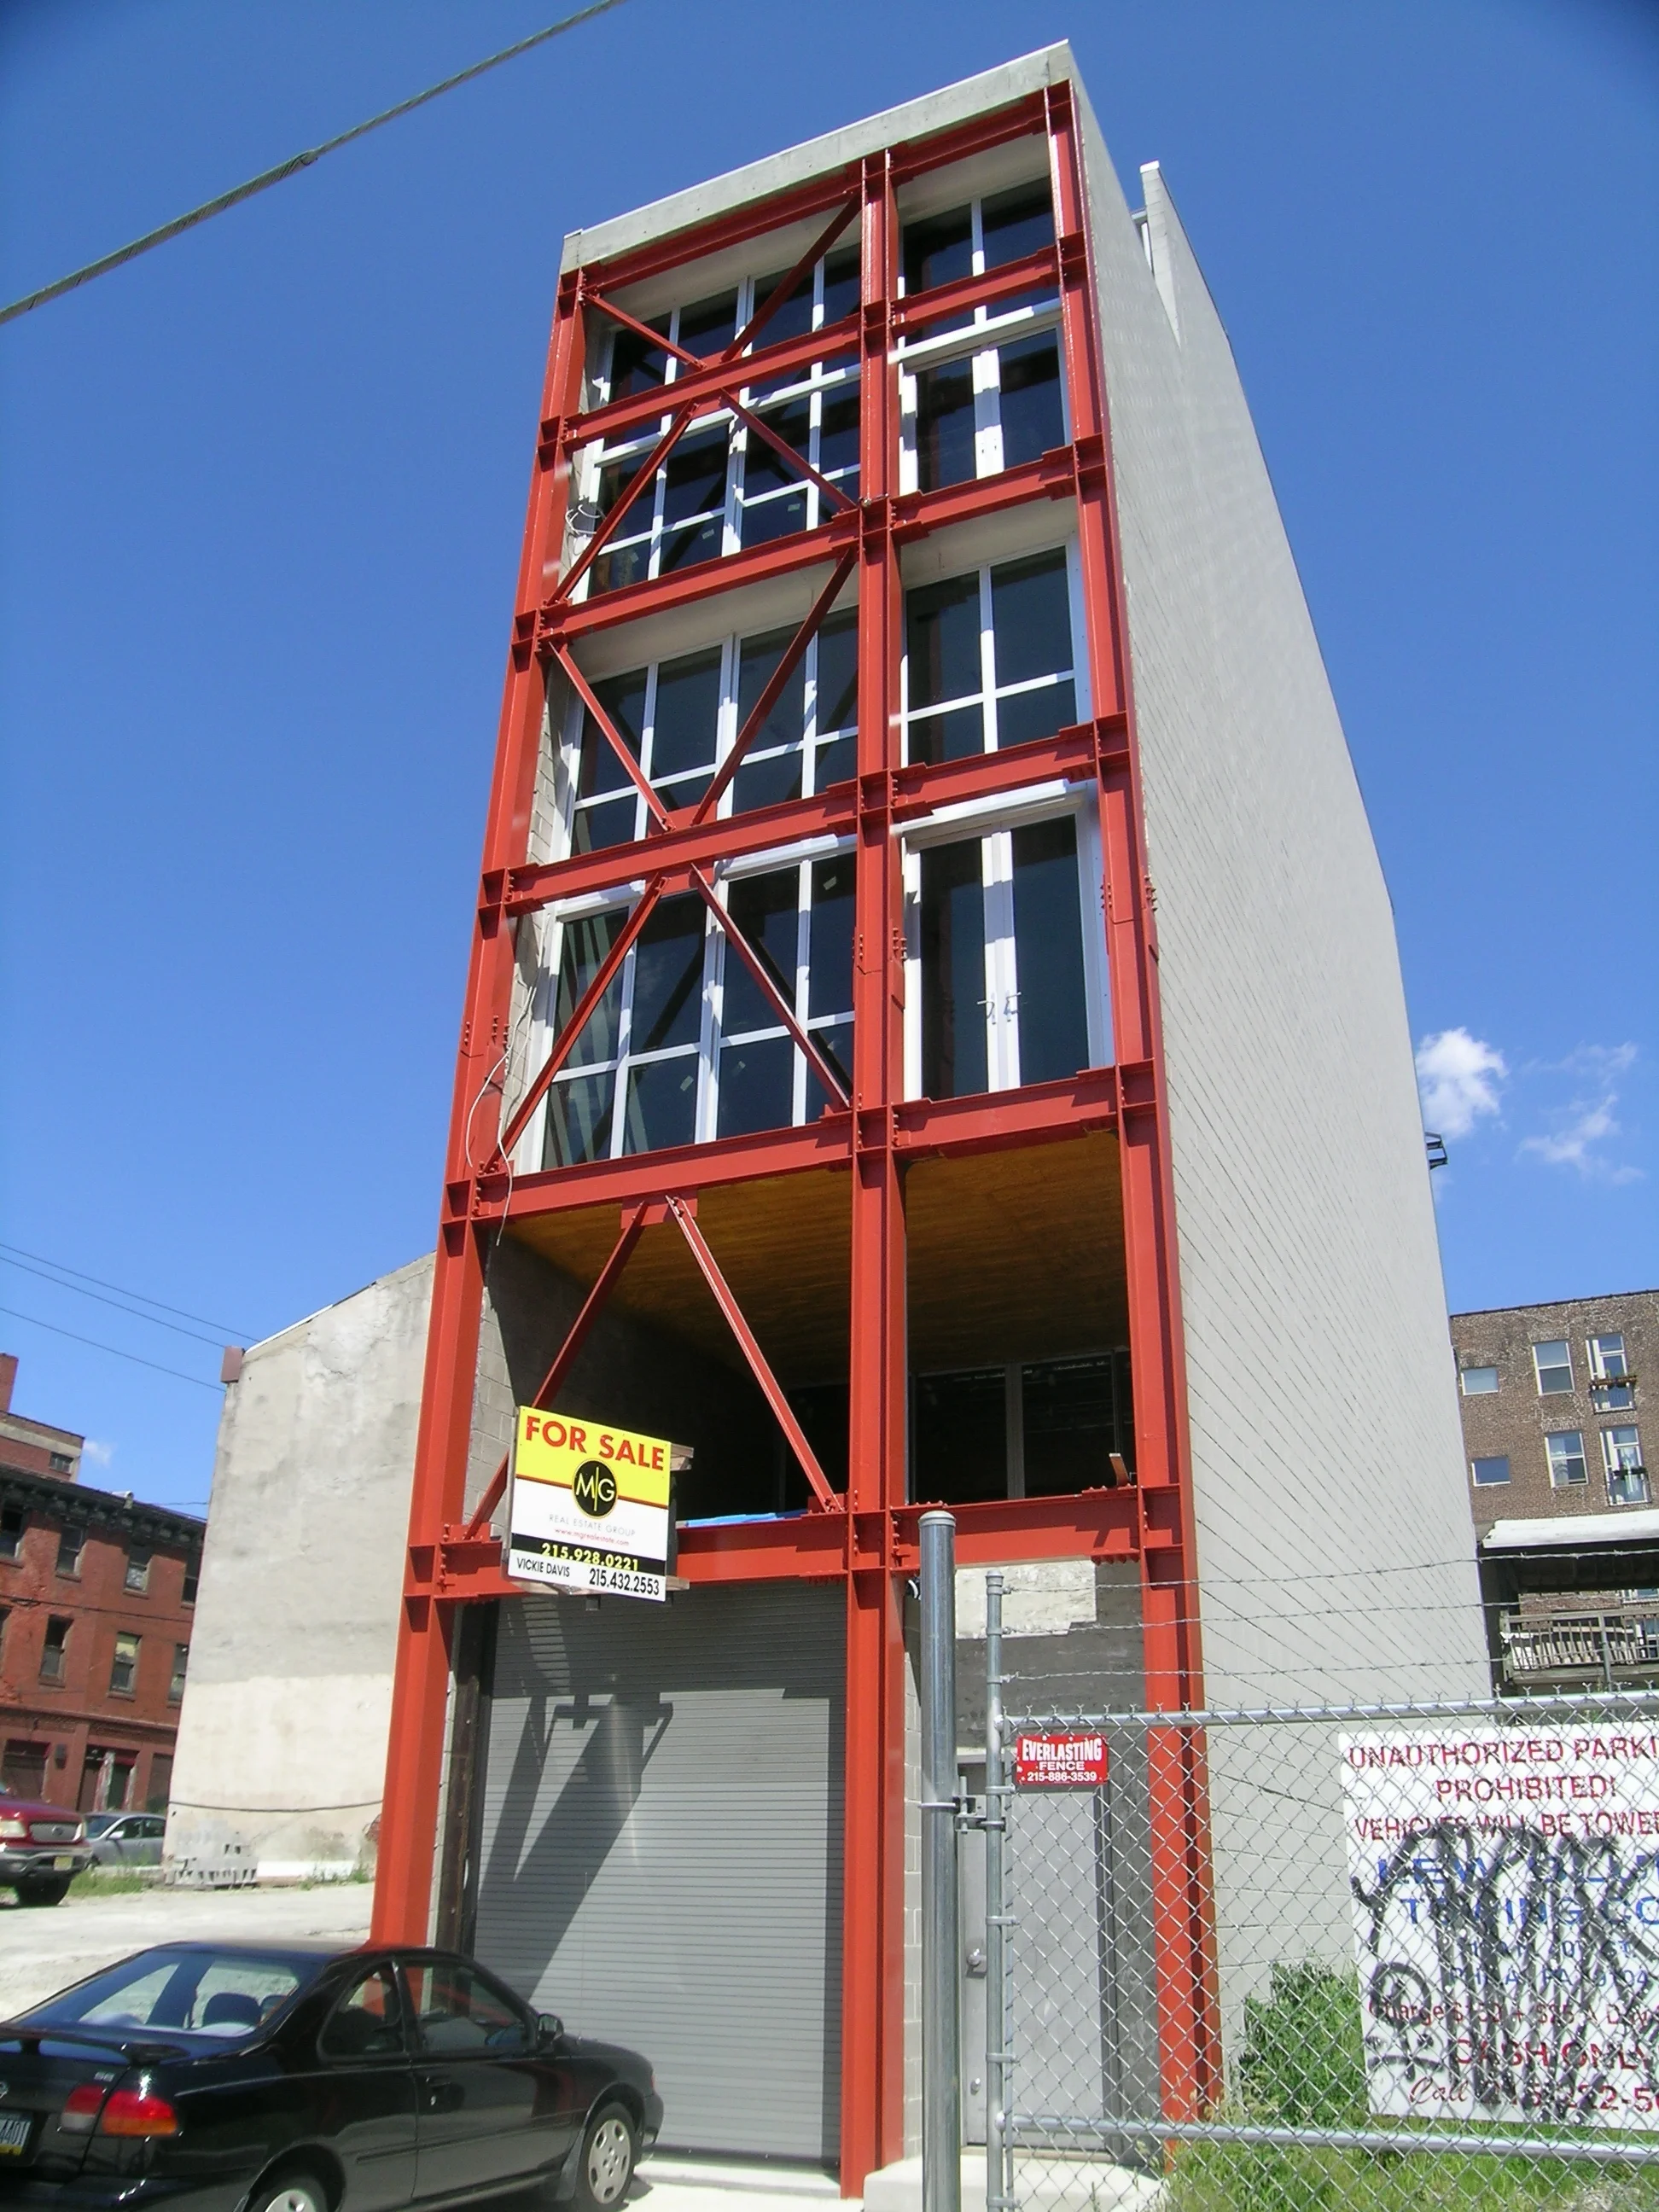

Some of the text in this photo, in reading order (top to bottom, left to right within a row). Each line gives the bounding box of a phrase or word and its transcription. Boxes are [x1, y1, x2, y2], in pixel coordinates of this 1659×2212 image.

[526, 1416, 664, 1471] FOR SALE
[549, 1513, 635, 1537] REAL ESTATE GROUP
[554, 1528, 629, 1546] www.mgrealestate.com
[541, 1542, 638, 1571] 215.928.0221
[516, 1557, 660, 1596] VICKIE DAVIS 215.432.2553
[1022, 1738, 1103, 1761] EVERLASTING
[1349, 1735, 1658, 1769] UNAUTHORIZED PARKI
[1027, 1771, 1097, 1782] 215-886-3539
[1039, 1761, 1086, 1771] FENCE
[1436, 1774, 1616, 1802] PROHIBITED!
[1540, 1813, 1573, 1837] BE
